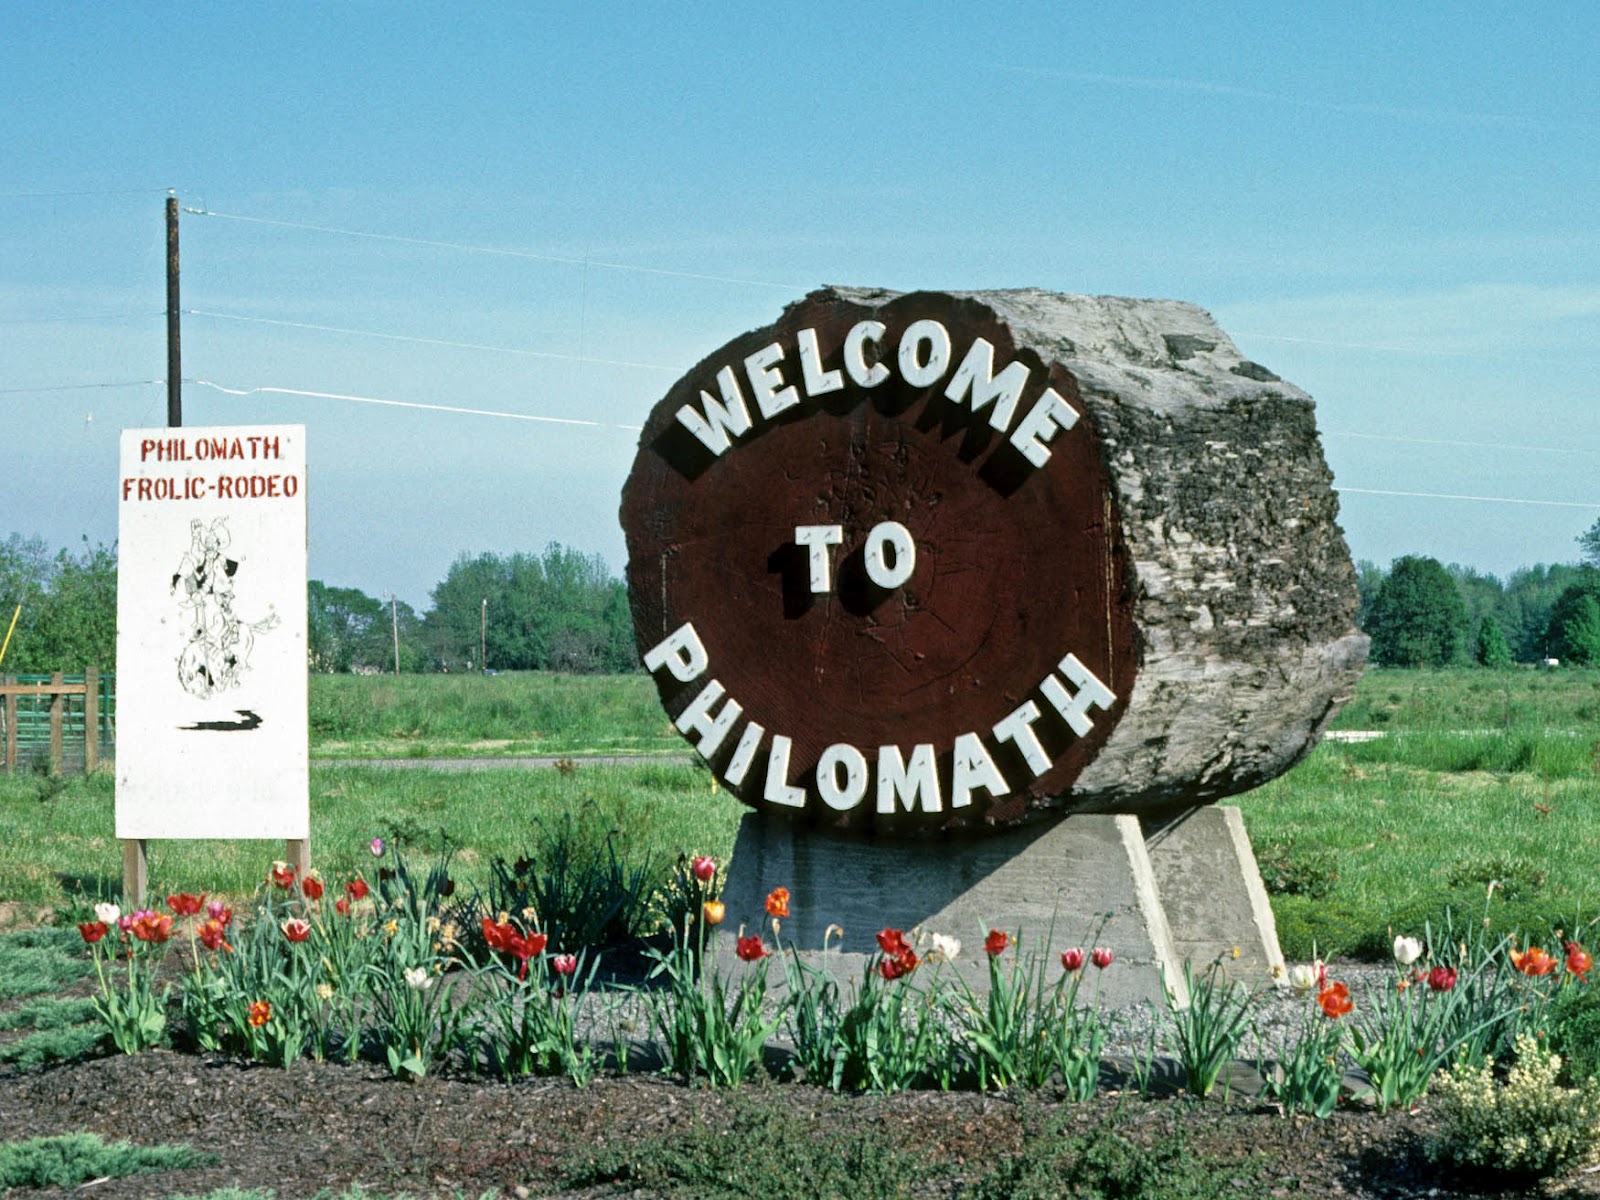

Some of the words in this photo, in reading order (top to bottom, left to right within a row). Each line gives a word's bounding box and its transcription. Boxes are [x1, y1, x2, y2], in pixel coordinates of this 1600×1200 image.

[676, 320, 1080, 468] WELCOME
[141, 436, 280, 462] PHILOMATH
[122, 475, 298, 501] FROLIC-RODEO
[795, 521, 916, 592] TO
[643, 622, 1117, 814] PHILOMATH
